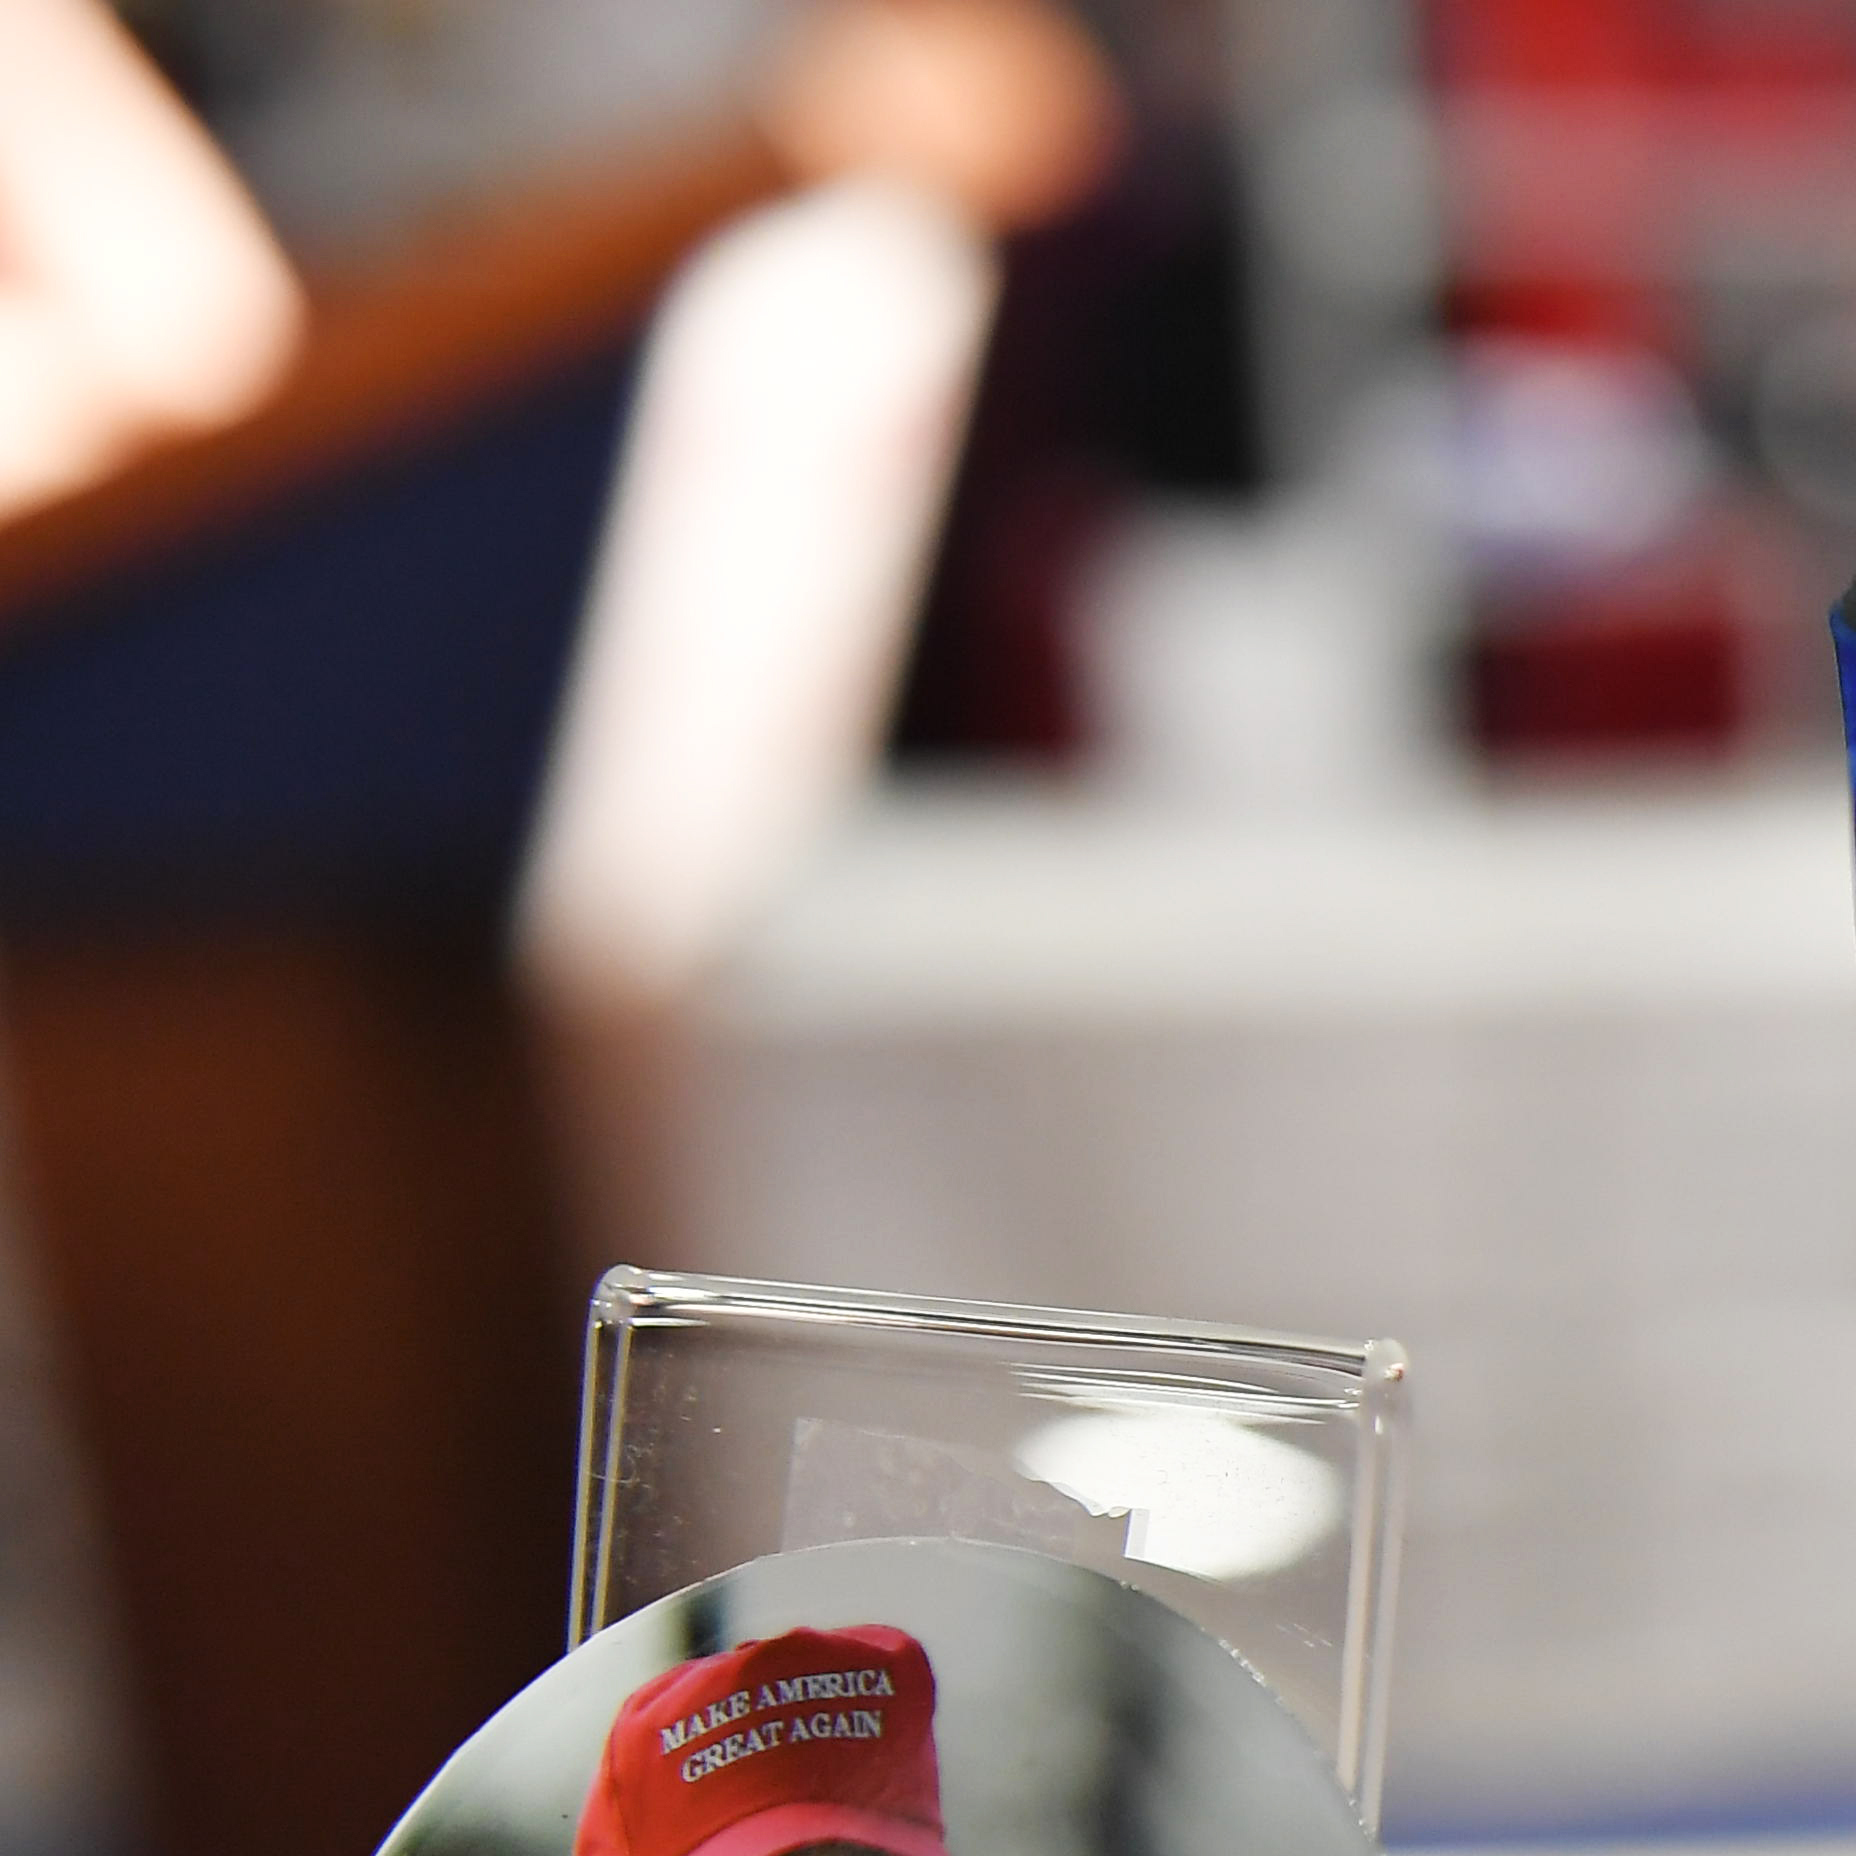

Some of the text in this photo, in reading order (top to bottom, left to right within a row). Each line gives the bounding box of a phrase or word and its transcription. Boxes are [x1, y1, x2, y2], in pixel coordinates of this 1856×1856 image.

[659, 1667, 895, 1756] MAKE AMERICA
[679, 1708, 883, 1785] GREAT AGAIN
